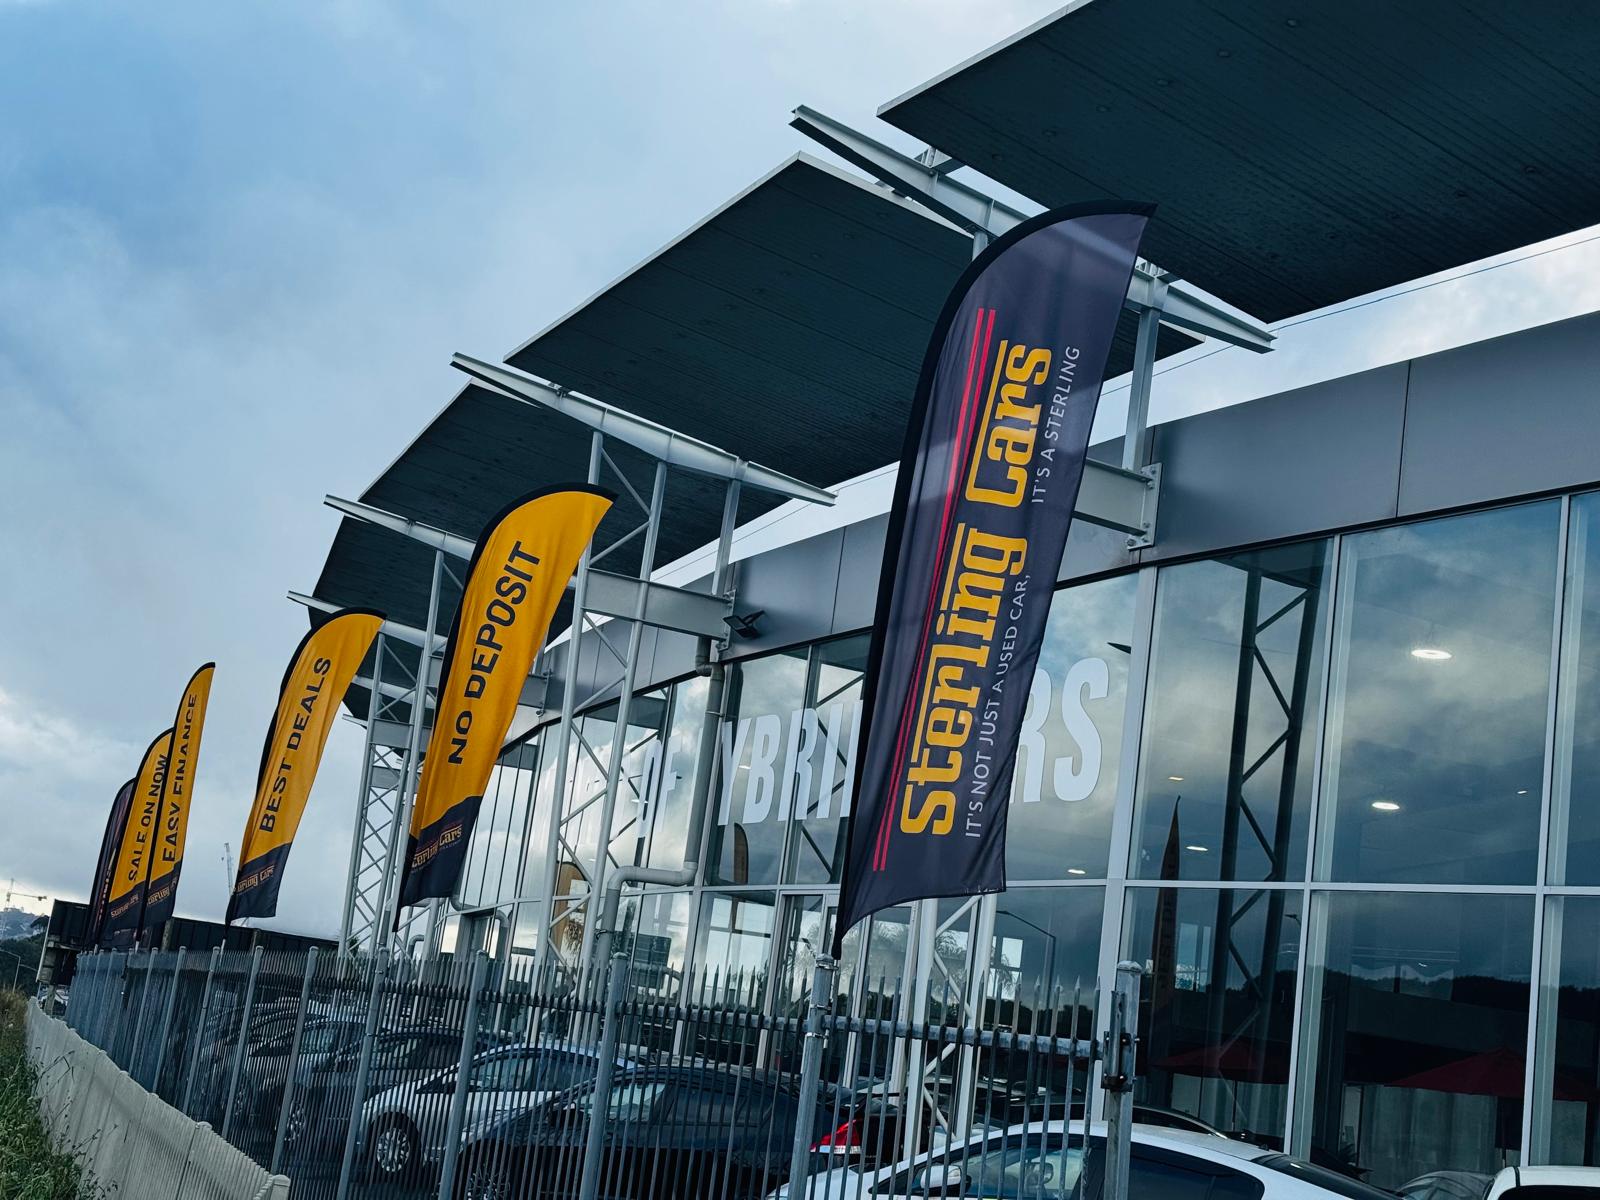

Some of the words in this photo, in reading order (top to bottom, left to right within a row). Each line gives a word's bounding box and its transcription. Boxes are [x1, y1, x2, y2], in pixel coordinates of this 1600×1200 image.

[1045, 346, 1080, 441] STERLING
[1040, 448, 1056, 462] A
[1031, 468, 1050, 503] IT'S
[900, 522, 1028, 836] Sterling
[964, 339, 1052, 508] Cars
[1010, 574, 1031, 621] CAR,
[447, 710, 473, 765] NO
[463, 540, 541, 699] DEPOSIT
[996, 628, 1018, 676] USED
[992, 678, 1003, 693] A
[172, 694, 197, 796] FINANCE
[259, 757, 292, 833] BEST
[286, 657, 331, 751] DEALS
[979, 698, 1001, 746] JUST
[148, 753, 168, 797] NOW
[971, 751, 992, 795] NOT
[141, 801, 156, 827] ON
[965, 800, 983, 838] IT'S
[128, 831, 148, 881] SALE
